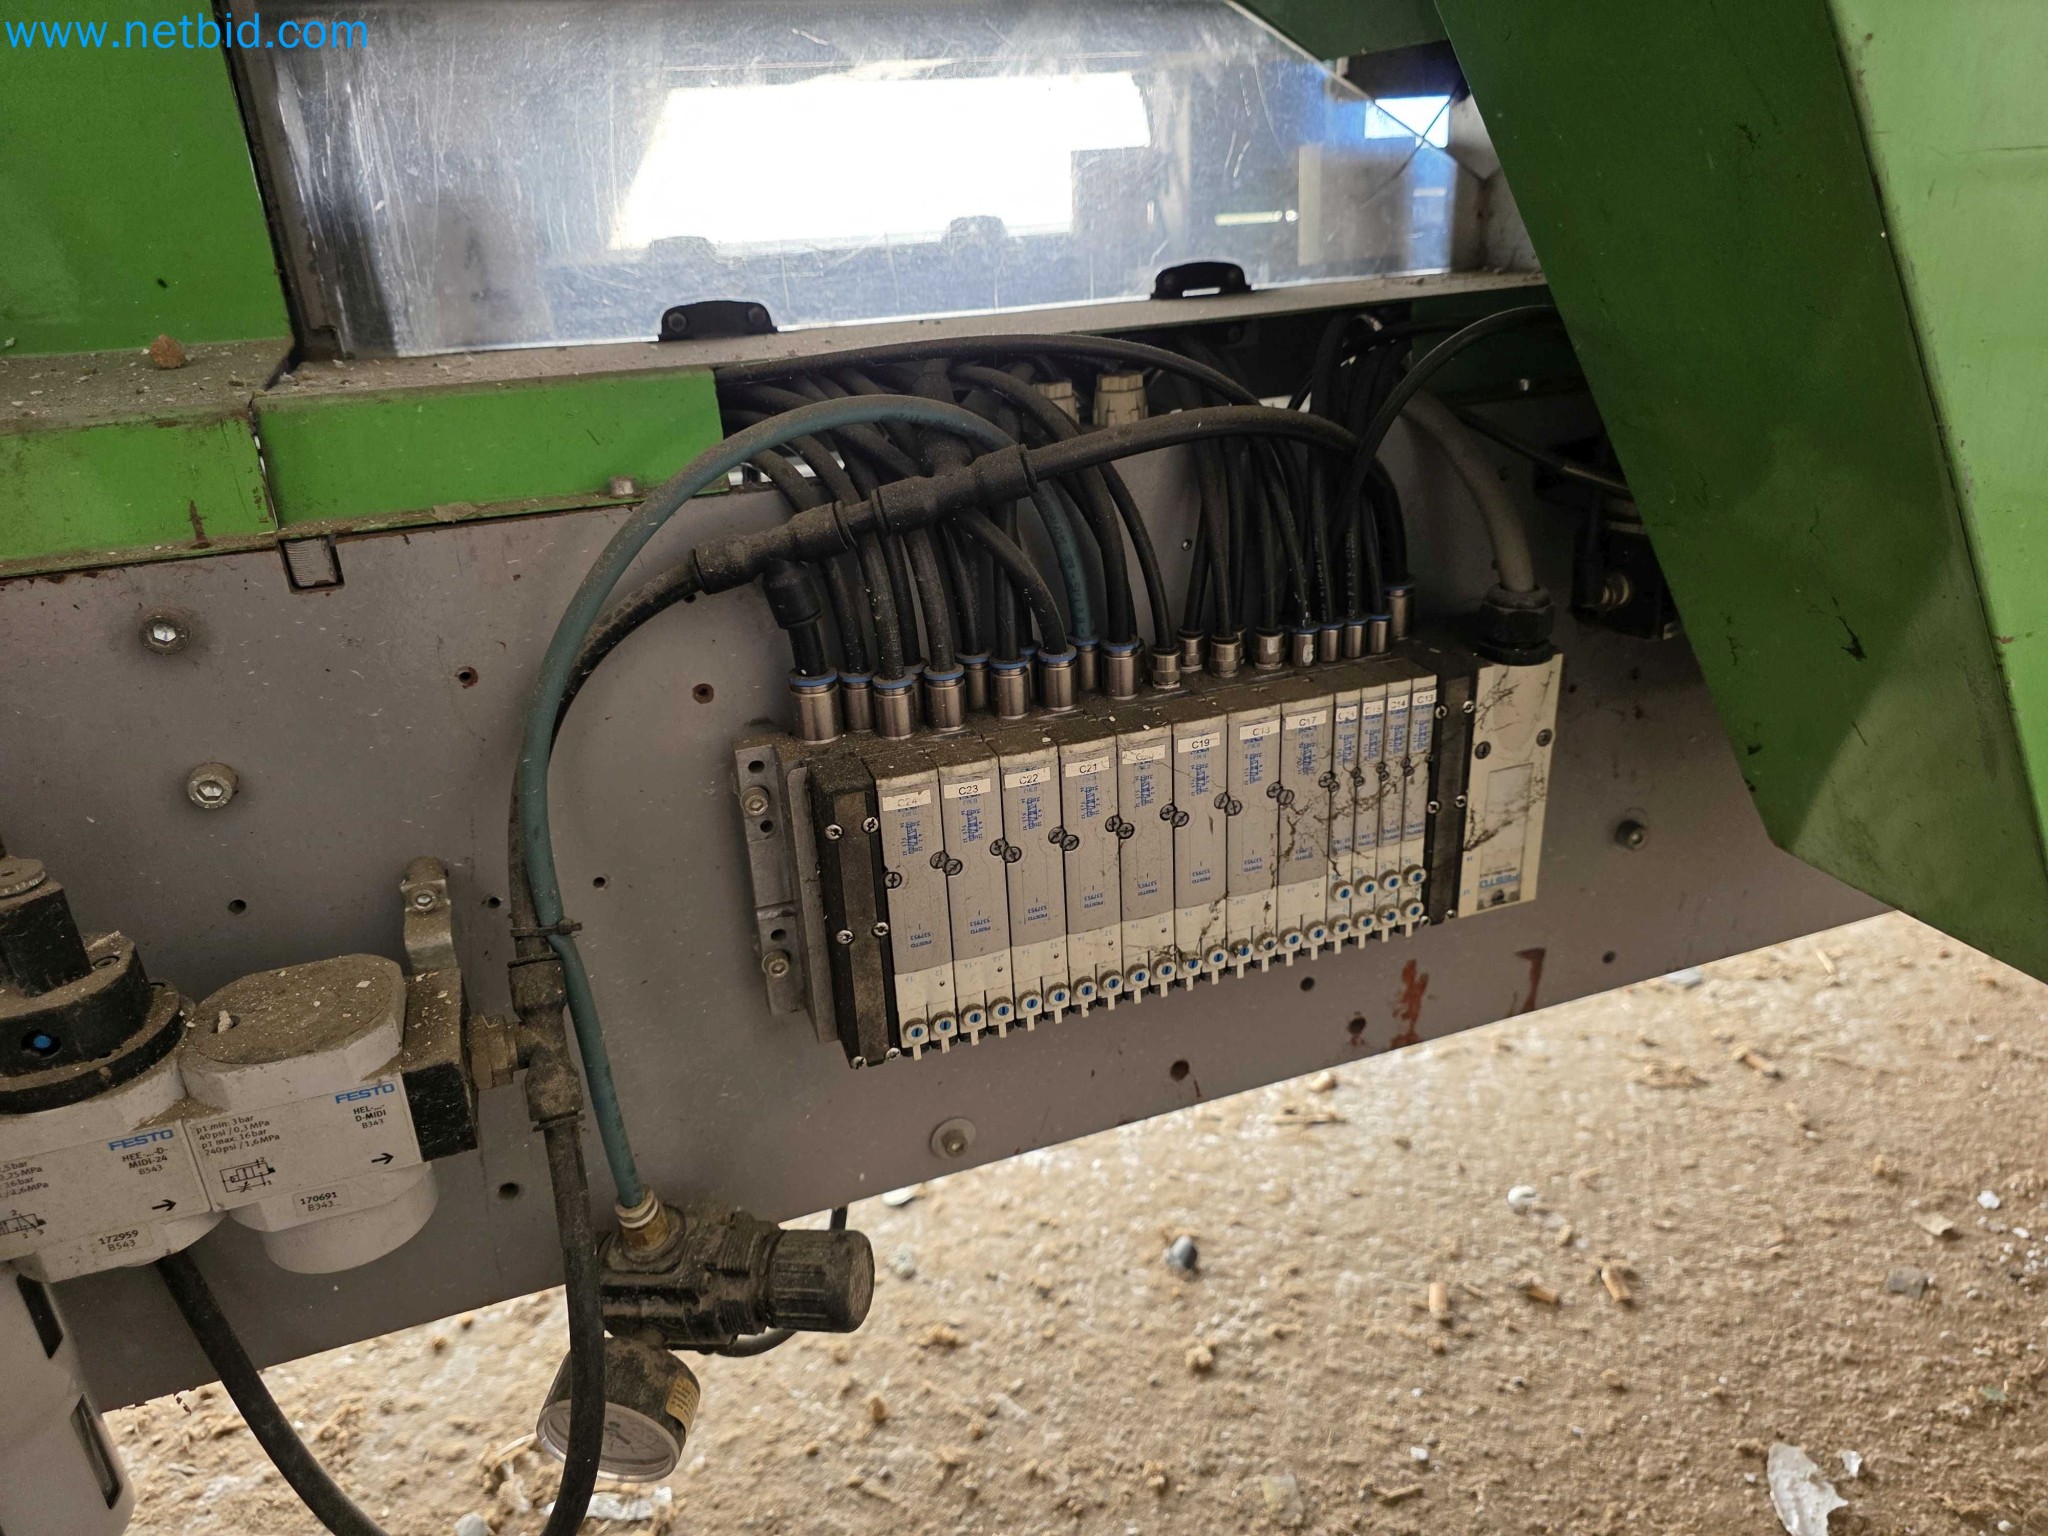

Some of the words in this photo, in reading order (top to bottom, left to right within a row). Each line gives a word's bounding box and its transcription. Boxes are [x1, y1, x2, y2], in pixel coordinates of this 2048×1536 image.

[1299, 716, 1317, 727] C17
[1192, 739, 1210, 750] C19
[1079, 763, 1098, 774] C21
[1019, 774, 1039, 785] C22
[958, 785, 979, 796] C23
[335, 1083, 395, 1104] FESTO
[355, 1109, 387, 1122] D-MIDI
[362, 1118, 384, 1129] B343
[108, 1129, 174, 1151] FESTO
[129, 1155, 168, 1169] MIDI-24
[300, 1191, 337, 1205] 170691
[308, 1200, 334, 1212] B343
[98, 1229, 139, 1245] 172959
[107, 1239, 136, 1252] B543
